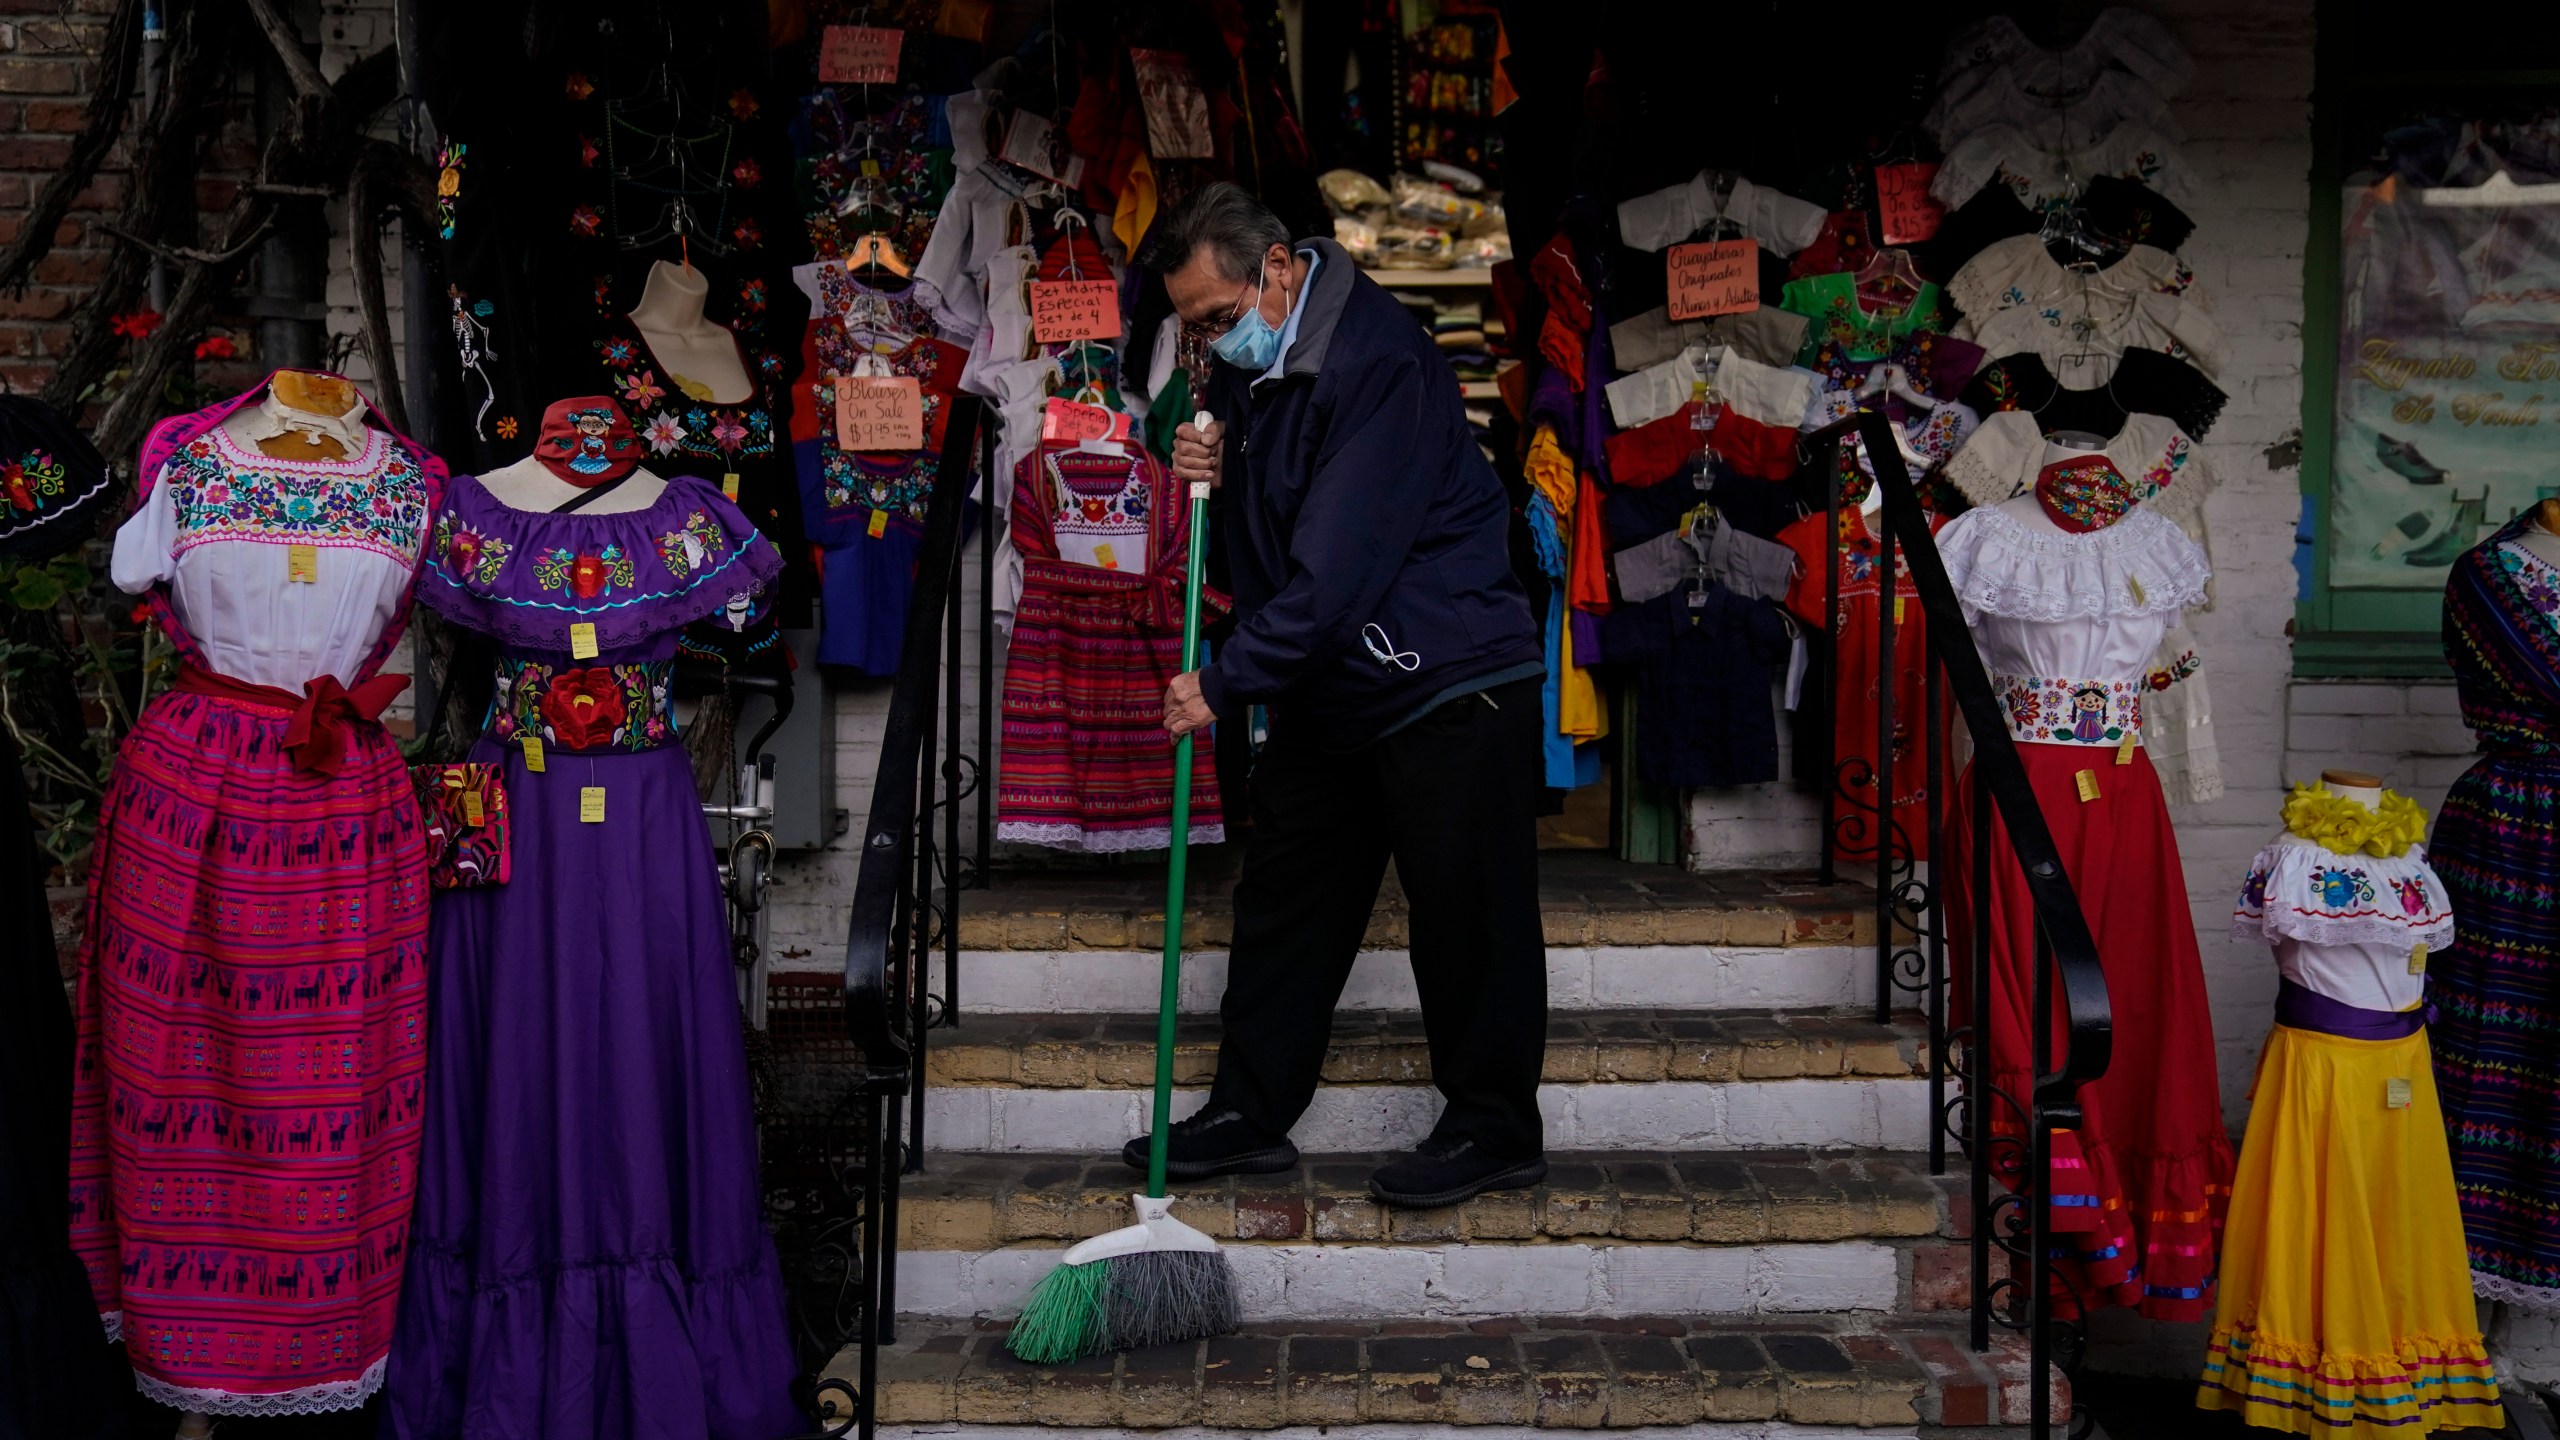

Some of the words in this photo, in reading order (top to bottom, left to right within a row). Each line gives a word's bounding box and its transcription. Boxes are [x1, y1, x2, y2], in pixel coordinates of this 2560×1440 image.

[1670, 246, 1745, 272] Guayaberas
[1679, 264, 1742, 290] Originales
[1034, 284, 1059, 299] Set
[1038, 313, 1063, 324] Set
[1071, 311, 1082, 321] de
[1090, 309, 1099, 325] 4
[2352, 338, 2476, 391] Zapato
[838, 377, 908, 402] Blouses
[848, 402, 867, 420] On
[875, 399, 904, 420] Sale
